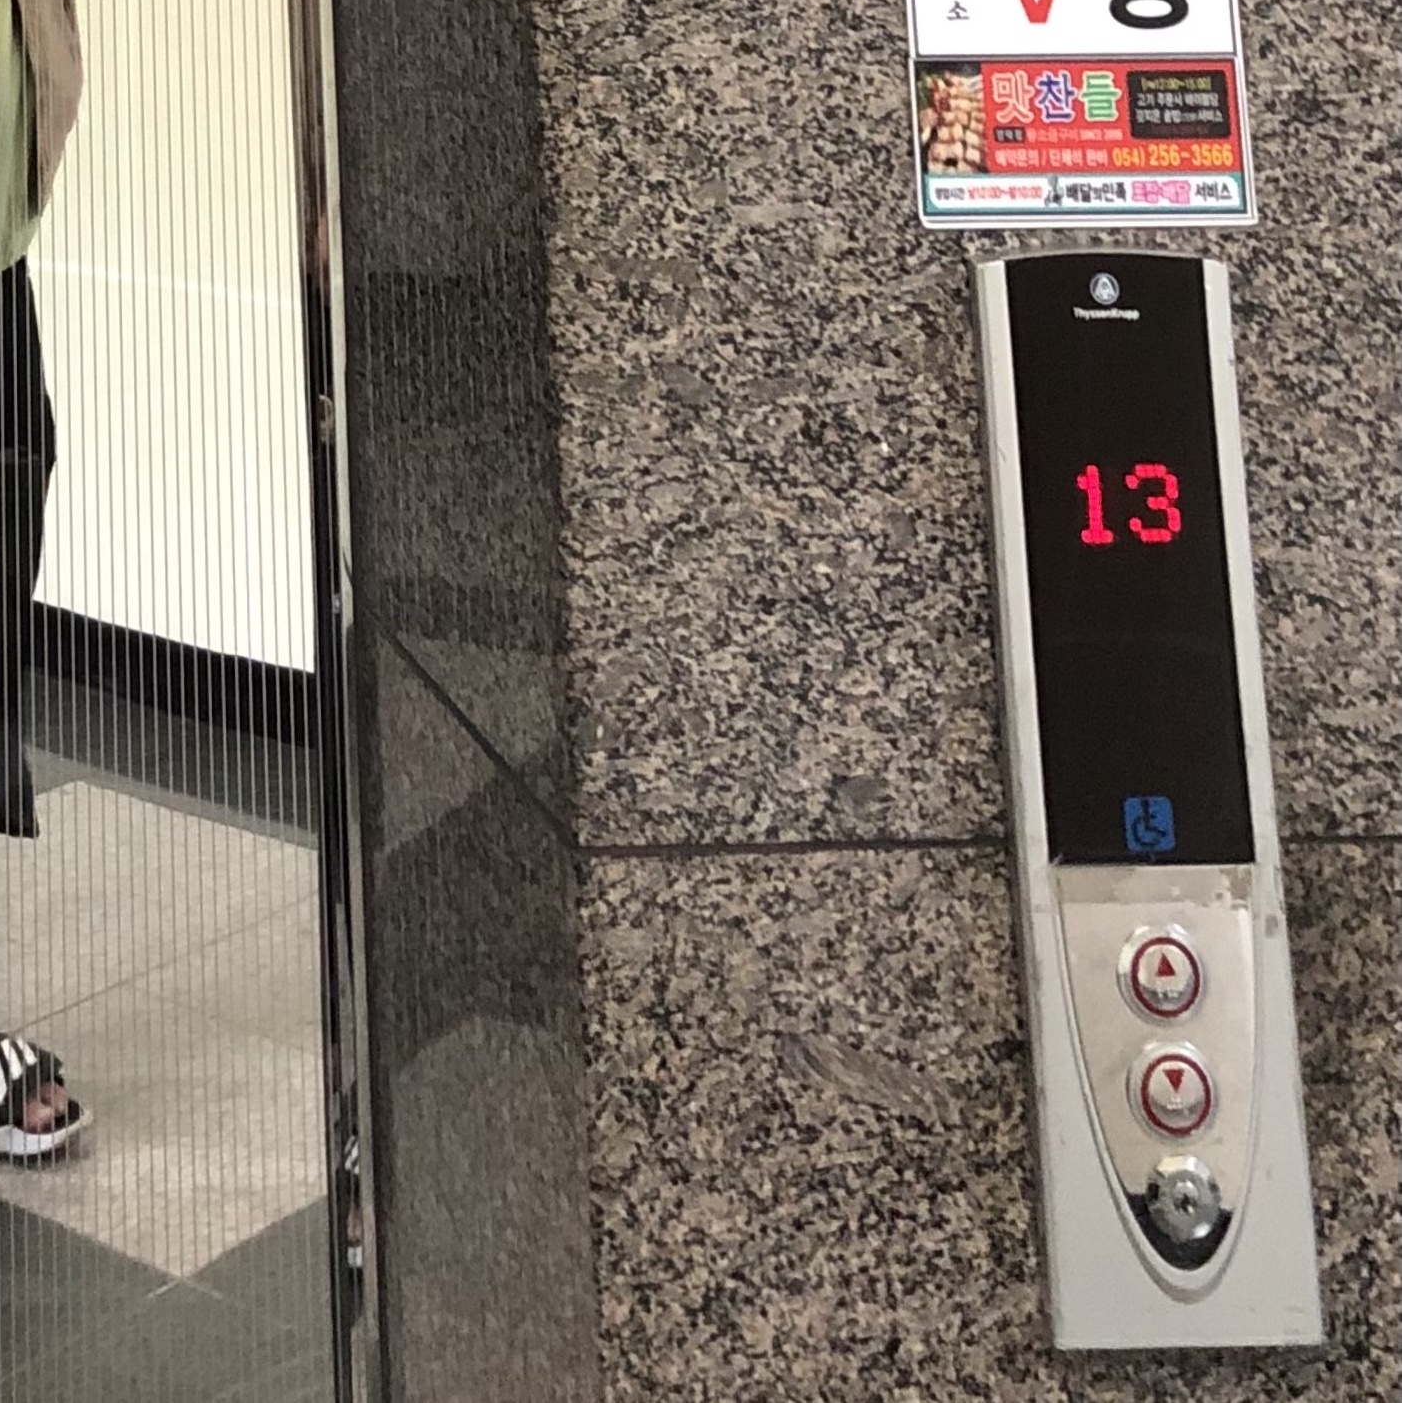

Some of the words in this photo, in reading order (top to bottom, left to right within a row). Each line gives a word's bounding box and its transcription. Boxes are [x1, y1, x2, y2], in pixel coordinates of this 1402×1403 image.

[990, 69, 1122, 126] 맛찬들
[1147, 143, 1234, 168] 256-3566
[1194, 180, 1234, 202] 서비스
[1076, 462, 1182, 546] 13
